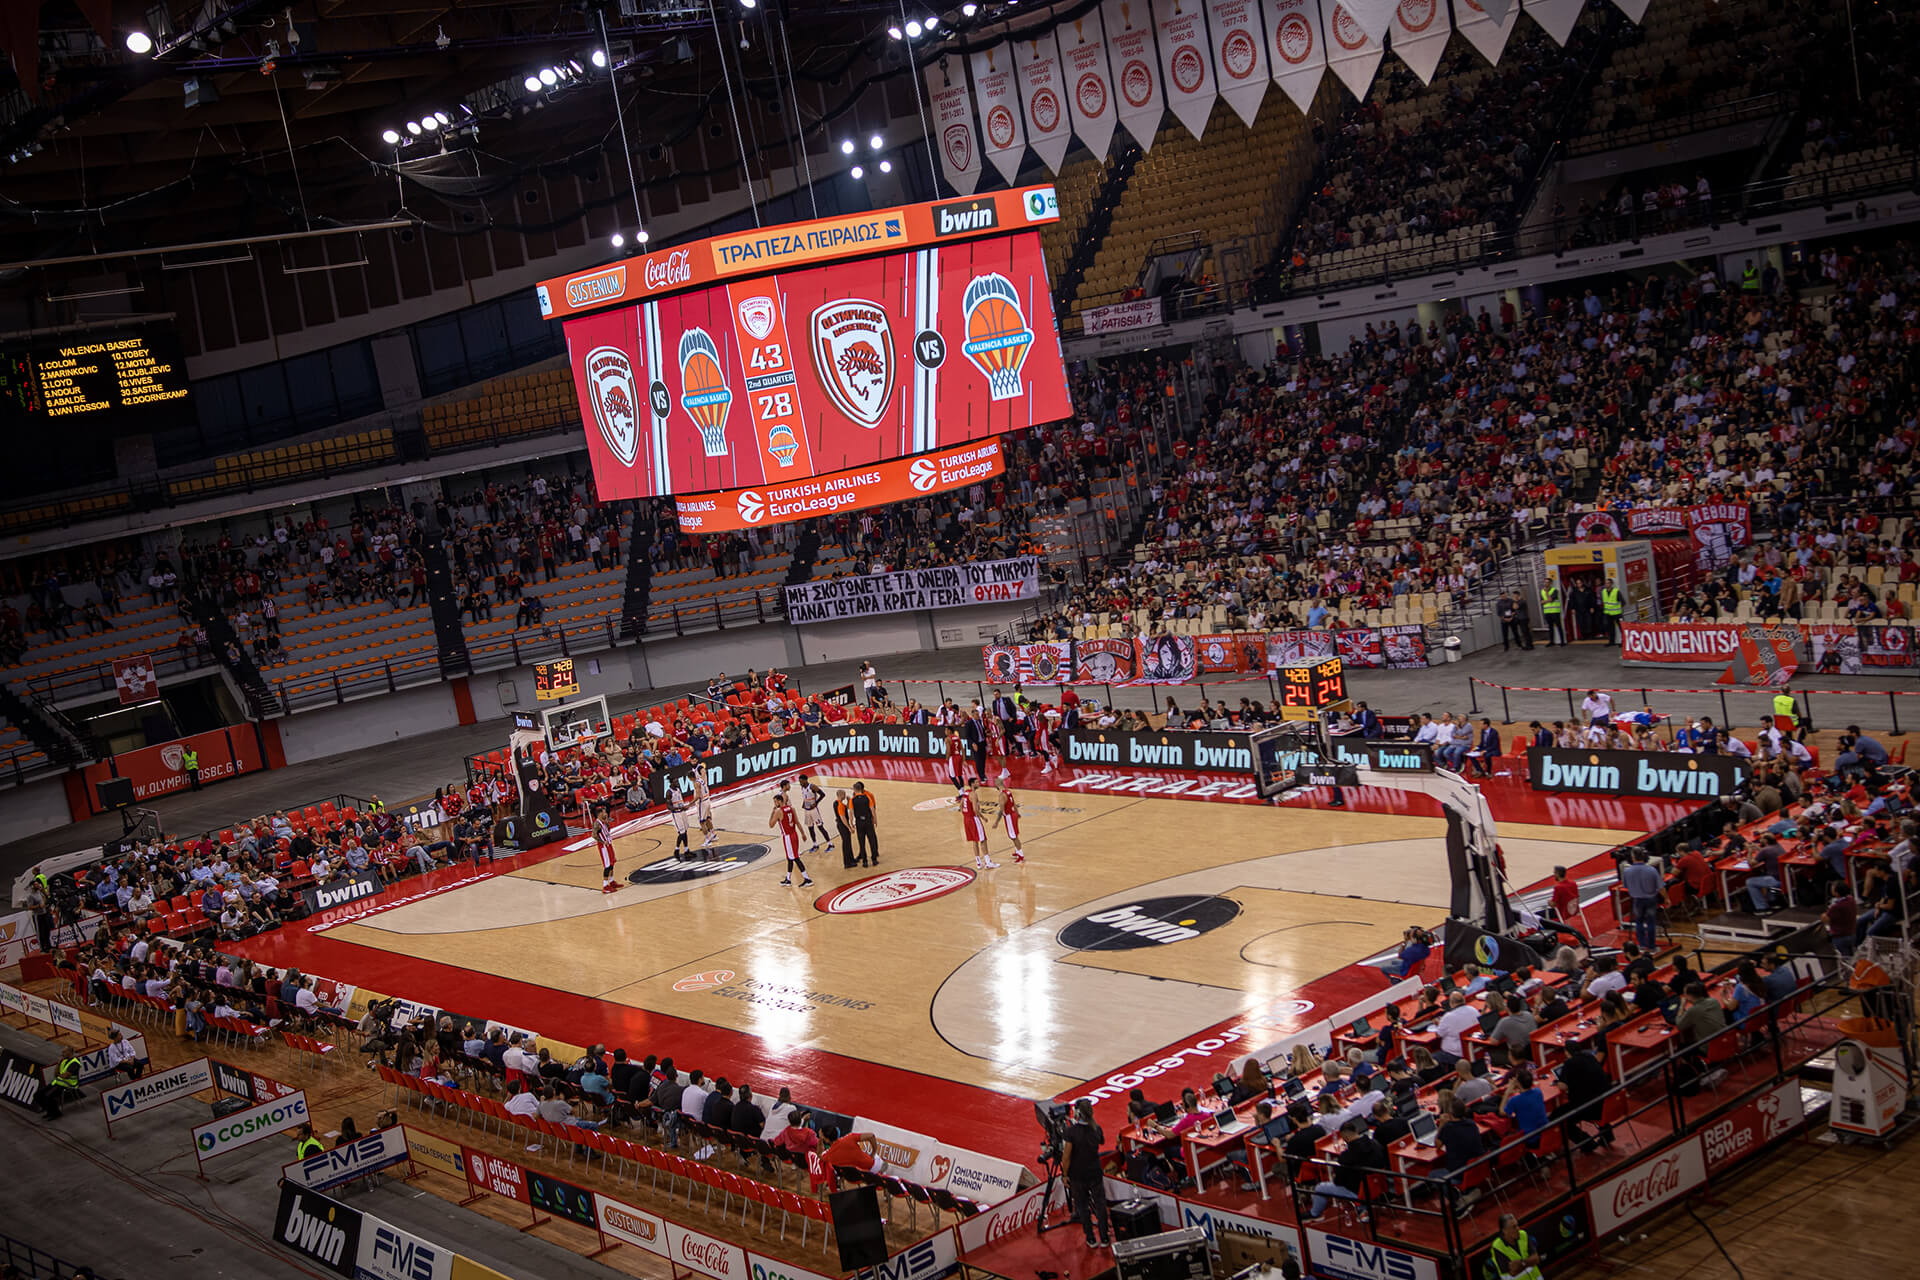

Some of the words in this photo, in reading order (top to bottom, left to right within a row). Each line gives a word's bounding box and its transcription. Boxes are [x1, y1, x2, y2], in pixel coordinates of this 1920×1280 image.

[940, 203, 992, 233] bwin
[718, 234, 805, 265] ΤΡΑΠΕΖΑ
[807, 222, 881, 250] ΠΕΙΡΑΙΩΣ
[645, 249, 691, 290] Coca-Cola
[569, 273, 620, 303] SUSTENIUM
[821, 309, 882, 330] OLYMPIACOS
[1091, 307, 1110, 319] RED
[1114, 301, 1153, 314] ILLNESS
[1101, 314, 1142, 329] PATISSIA
[833, 322, 878, 338] BASKETBALL
[60, 343, 105, 357] VALENCIA
[106, 338, 142, 351] BASKET
[111, 349, 149, 361] 10.TOBEY
[920, 338, 940, 361] VS
[968, 340, 1001, 353] VALENCIA
[1002, 333, 1028, 346] BASKET
[38, 359, 77, 371] 1.COLOM
[114, 358, 156, 370] 12.MOTUM
[592, 355, 628, 374] OLYMPIACOS
[750, 344, 784, 370] 43
[40, 366, 98, 380] 2.MARINKOVIC
[42, 379, 73, 389] 3.LOYD
[117, 365, 171, 379] 14.DUBLJEVIC
[748, 380, 761, 389] 2nd
[762, 373, 794, 386] QUARTER
[44, 387, 81, 399] 5.NDOUR
[46, 395, 86, 408] 6.ABALDE
[120, 384, 163, 397] 30.SASTRE
[121, 389, 188, 406] 42.DOORNEKAMP
[653, 390, 667, 410] VS
[685, 396, 709, 406] VALENCIA
[710, 392, 728, 402] BASKET
[48, 405, 73, 417] 9.VAN
[74, 401, 110, 413] ROSSOM
[758, 392, 793, 420] 28
[938, 453, 975, 469] TURKISH
[977, 443, 998, 459] AIRLINES
[941, 460, 993, 484] EuroLeague
[767, 485, 821, 503] TURKISH
[824, 471, 881, 493] AIRLINES
[687, 500, 716, 513] AIRLINES
[769, 492, 856, 518] EuroLeague
[1689, 504, 1747, 526] ΜΕΘΩΝΗ
[787, 587, 808, 604] ΜΗ
[813, 574, 893, 600] ΣΚΟΤΩΝΕΤΕ
[898, 574, 914, 590] ΤΑ
[918, 566, 960, 588] ΟΝΕΙΡΑ
[965, 565, 989, 584] ΤΟΥ
[992, 558, 1035, 580] ΜΙΚΡΟΥ
[789, 596, 880, 621] ΠΑΝΑΓΙΩΤΑΡΑ
[884, 589, 925, 611] ΚΡΑΤΑ
[929, 587, 966, 606] ΓΕΡΑ!
[974, 583, 1011, 601] ΘΥΡΑ
[1012, 580, 1024, 598] 7
[1270, 631, 1331, 646] MISFITS
[1624, 629, 1739, 654] IGOUMENITSA
[553, 659, 573, 671] 4:28
[1285, 669, 1310, 683] 4:28
[1317, 658, 1342, 677] 4:28
[537, 676, 549, 690] 24
[553, 672, 572, 689] 24
[1318, 677, 1342, 704] 24
[1285, 685, 1311, 706] 24
[516, 715, 533, 728] bwin
[811, 728, 869, 757] bwin
[878, 729, 919, 754] bwin
[928, 731, 971, 756] bwn
[1069, 734, 1118, 762] bwin
[1130, 736, 1182, 765] bwin
[1194, 739, 1250, 768] bwin
[736, 740, 797, 776] bwin
[1379, 750, 1421, 768] bwin
[663, 761, 722, 798] bwn
[1309, 771, 1336, 785] bwin
[1541, 754, 1620, 789] bwin
[1637, 759, 1719, 795] bwin
[532, 824, 559, 838] COSMOTE
[307, 872, 495, 933] @olympiacosbc
[316, 879, 373, 908] bwin
[1086, 905, 1200, 944] bwin
[712, 986, 817, 1013] EuroLegue
[795, 991, 876, 1011] AIRLINES
[1069, 1014, 1282, 1106] uroLeague
[1, 1058, 39, 1105] bwin
[134, 1072, 188, 1100] MARINE
[219, 1066, 249, 1098] bwin
[253, 1075, 268, 1091] RED
[218, 1100, 306, 1142] COSMOTE
[1704, 1120, 1734, 1148] RED
[1707, 1128, 1753, 1164] POWER
[303, 1133, 385, 1181] FMS
[861, 1141, 911, 1167] SUTENIUM
[489, 1158, 521, 1184] official
[954, 1165, 981, 1182] ΟΜΙΛΟΣ
[982, 1171, 1013, 1190] ΙΑΤΡΙΚΟΥ
[493, 1178, 517, 1199] store
[951, 1176, 982, 1192] ΑΘΗΝΩΝ
[1613, 1151, 1681, 1218] Coca-Cola
[606, 1209, 651, 1239] SUSTENIUM
[985, 1185, 1056, 1246] Coca-Coa
[284, 1194, 346, 1266] bwin
[374, 1227, 434, 1280] FMS
[682, 1233, 729, 1275] Coca-Cola
[866, 1240, 936, 1280] MS
[1325, 1234, 1415, 1280] FMS
